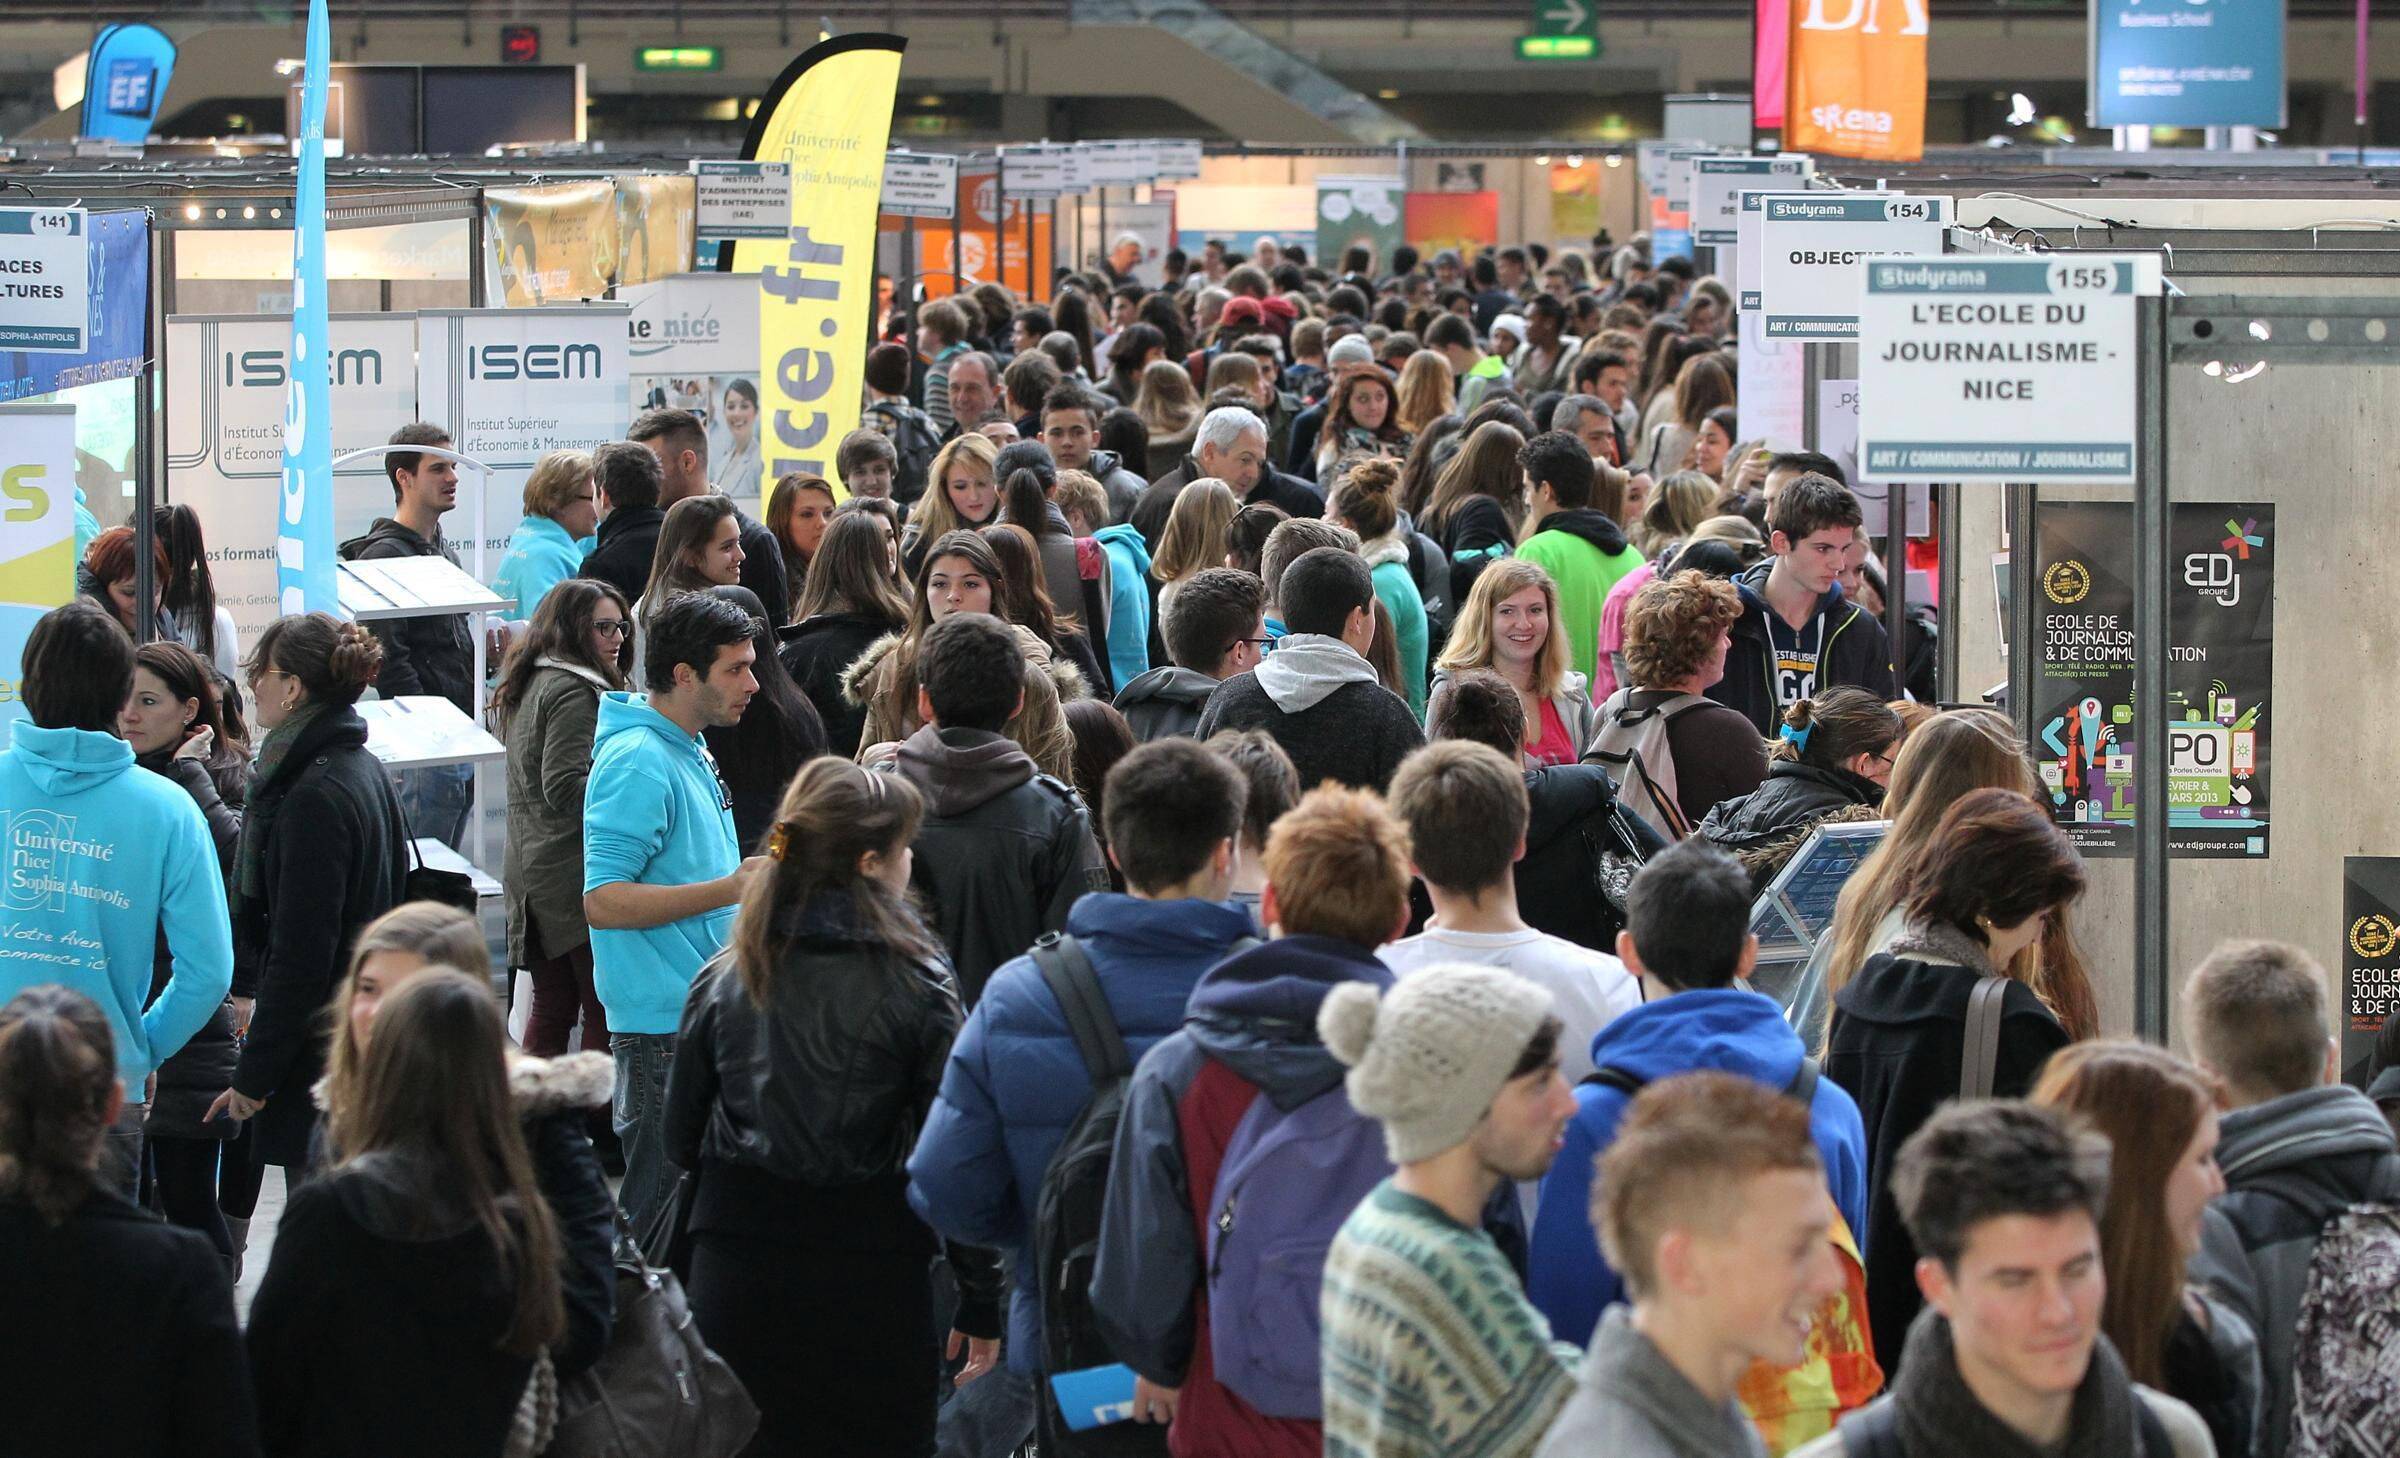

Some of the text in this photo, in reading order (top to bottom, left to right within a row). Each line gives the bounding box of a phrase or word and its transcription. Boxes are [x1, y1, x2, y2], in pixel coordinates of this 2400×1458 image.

[110, 76, 149, 109] EF
[1774, 202, 1924, 218] Studyrama 154
[39, 215, 66, 228] 141
[1877, 267, 2108, 290] Studyrama 155
[1744, 297, 1760, 306] ART
[1912, 304, 2087, 324] L'ECOLE DU
[1769, 322, 1785, 332] ART
[469, 343, 602, 381] ISEM
[1882, 342, 2099, 363] JOURNALISME
[225, 349, 382, 388] ISM
[1963, 379, 2035, 400] NICE
[224, 425, 269, 440] Institut
[467, 416, 559, 434] Institut Supérieur
[467, 434, 529, 453] d'Économie
[532, 438, 541, 451] &
[1870, 451, 1899, 468] ART
[1909, 450, 2022, 468] COMMUNICATION
[2032, 451, 2128, 469] JOURNALISME
[2183, 553, 2240, 607] EDJ
[2198, 588, 2229, 596] GROUPE
[2045, 614, 2119, 630] ECOLE DE
[2045, 647, 2056, 661] &
[2060, 646, 2079, 661] DE
[2201, 780, 2210, 791] &
[2193, 792, 2219, 803] 2013
[14, 829, 115, 863] Université
[12, 868, 132, 911] Sophia Antipolis
[2, 921, 54, 943] Votre
[2352, 999, 2362, 1014] &
[2366, 999, 2386, 1014] DE
